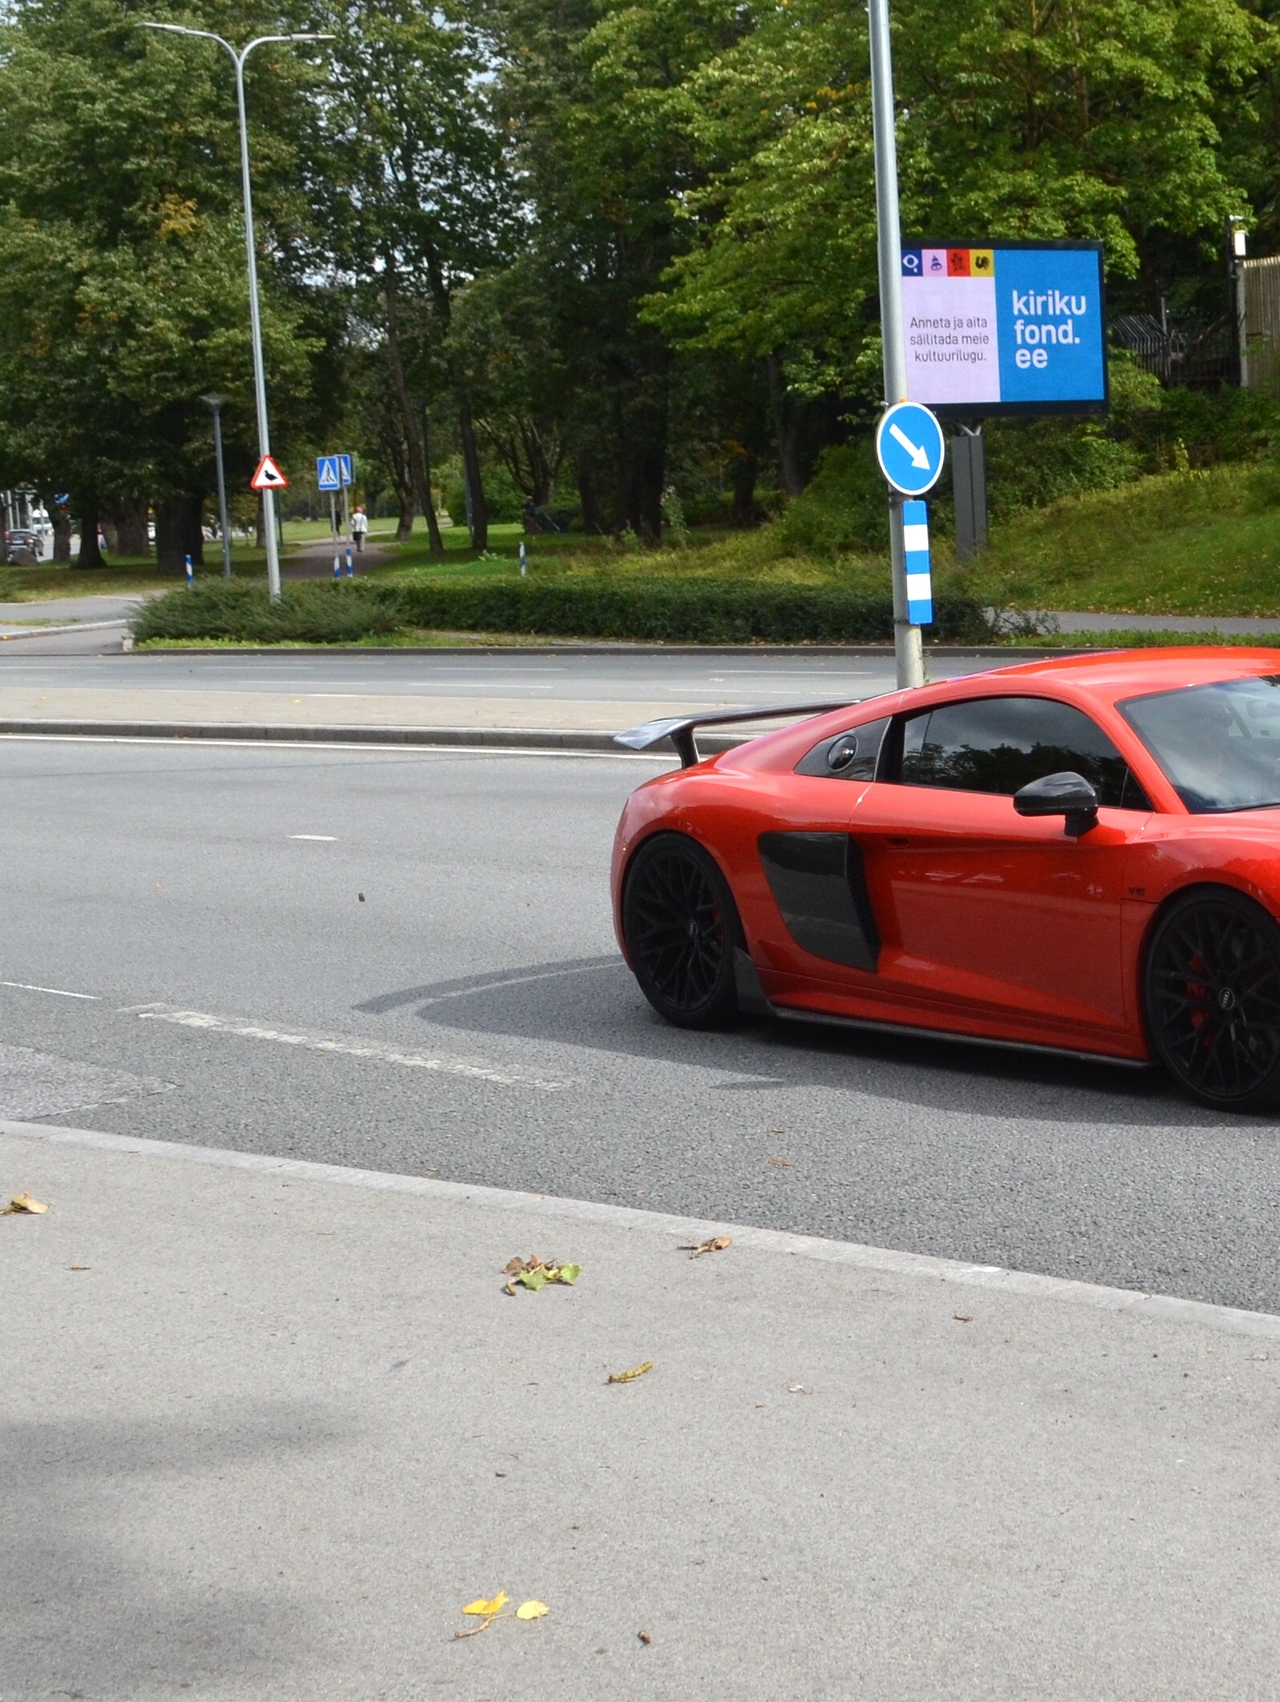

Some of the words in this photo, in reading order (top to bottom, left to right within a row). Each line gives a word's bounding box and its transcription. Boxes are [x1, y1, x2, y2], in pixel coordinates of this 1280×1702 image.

[1012, 290, 1086, 315] kiriku
[910, 317, 951, 329] Anneta
[953, 318, 964, 331] ja
[966, 317, 988, 328] aita
[1014, 319, 1080, 344] fond.
[910, 332, 959, 346] säilitada
[961, 334, 989, 345] meie
[914, 350, 987, 364] kultuurilugu.
[1015, 348, 1048, 369] ee
